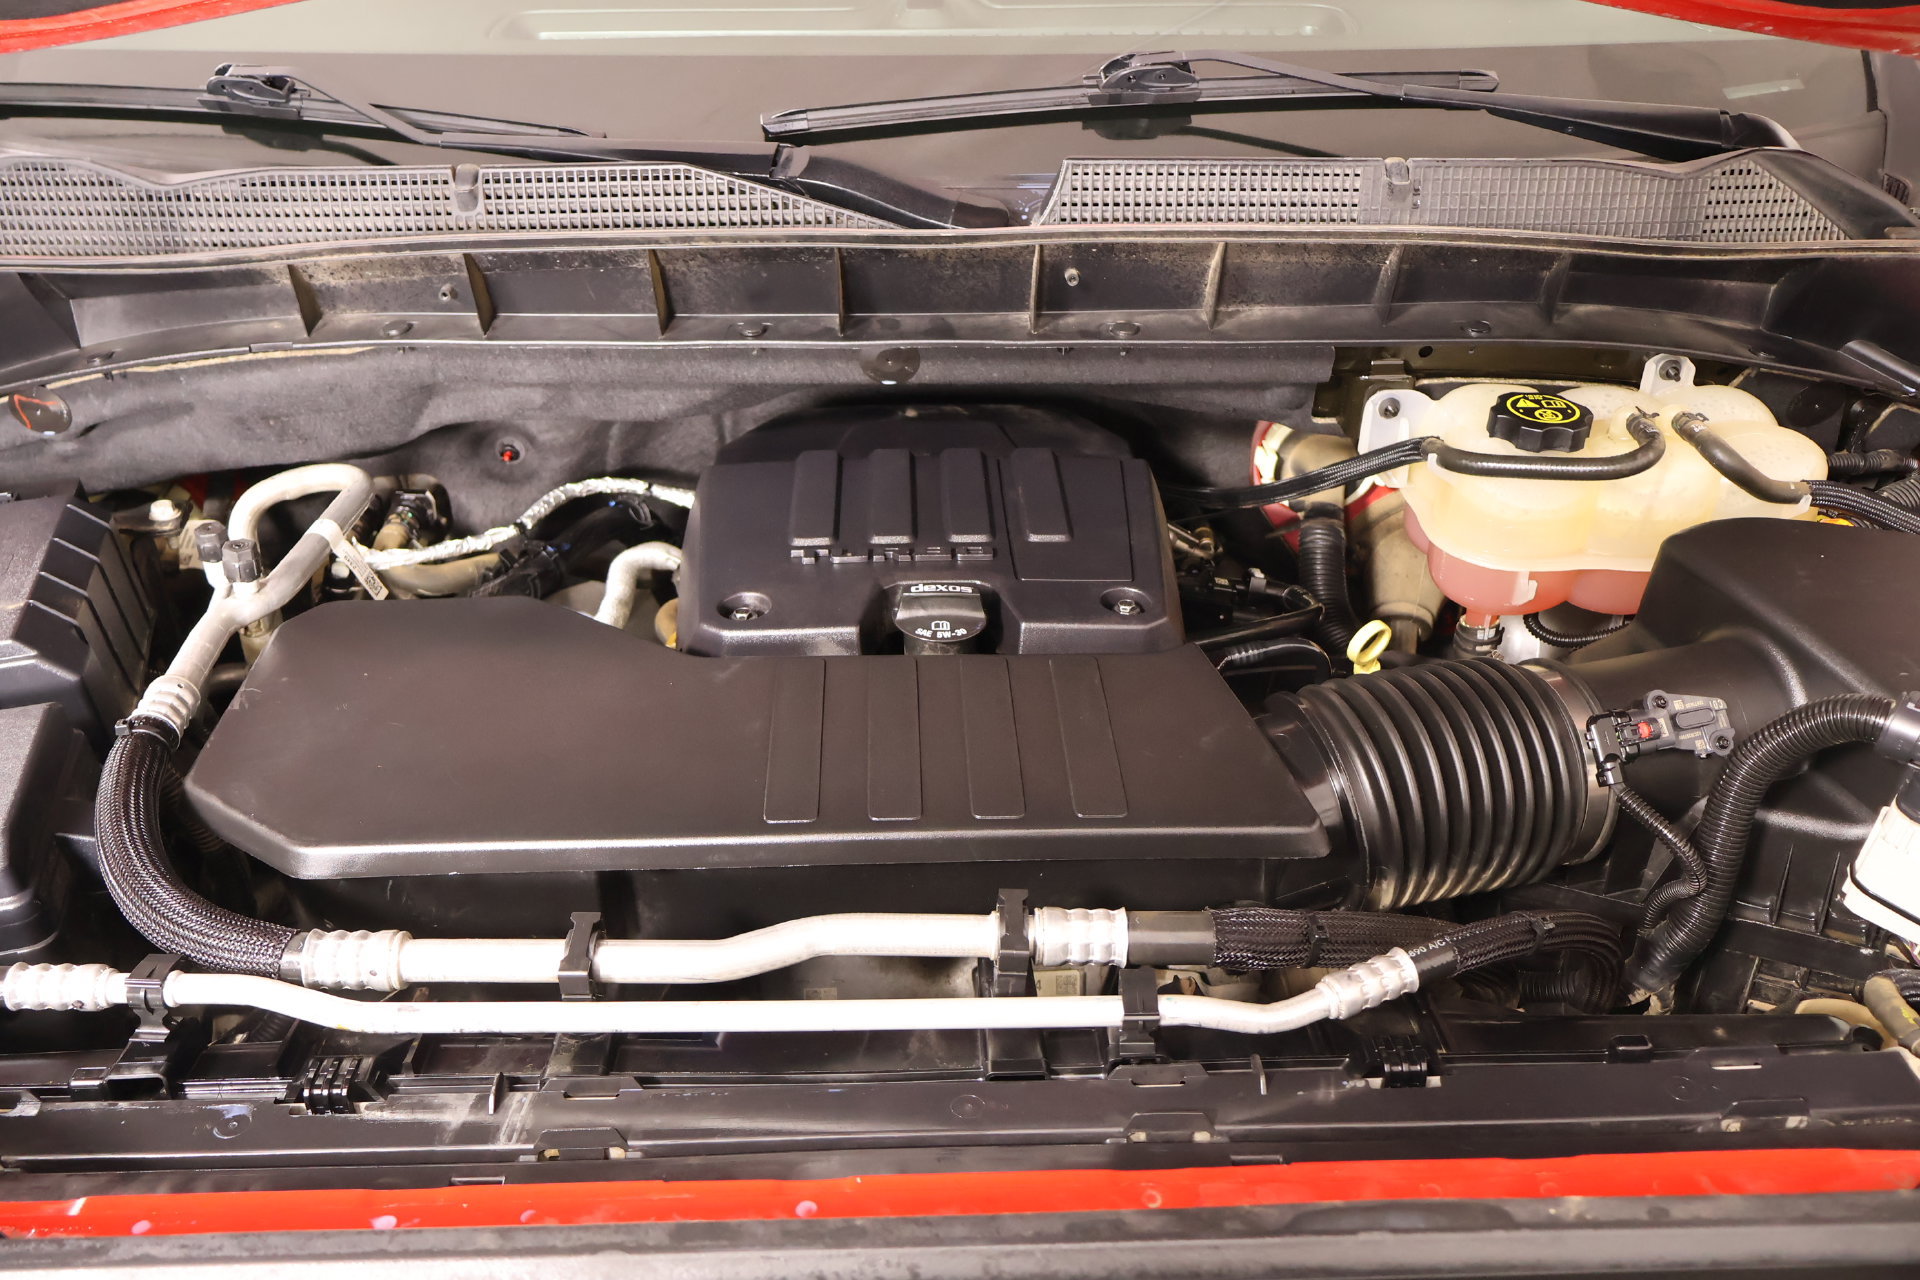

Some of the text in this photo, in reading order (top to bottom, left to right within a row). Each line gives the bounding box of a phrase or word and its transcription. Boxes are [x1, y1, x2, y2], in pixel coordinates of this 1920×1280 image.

[910, 583, 973, 593] dexos
[915, 628, 968, 639] SAE 5W-30
[1408, 945, 1427, 957] 890
